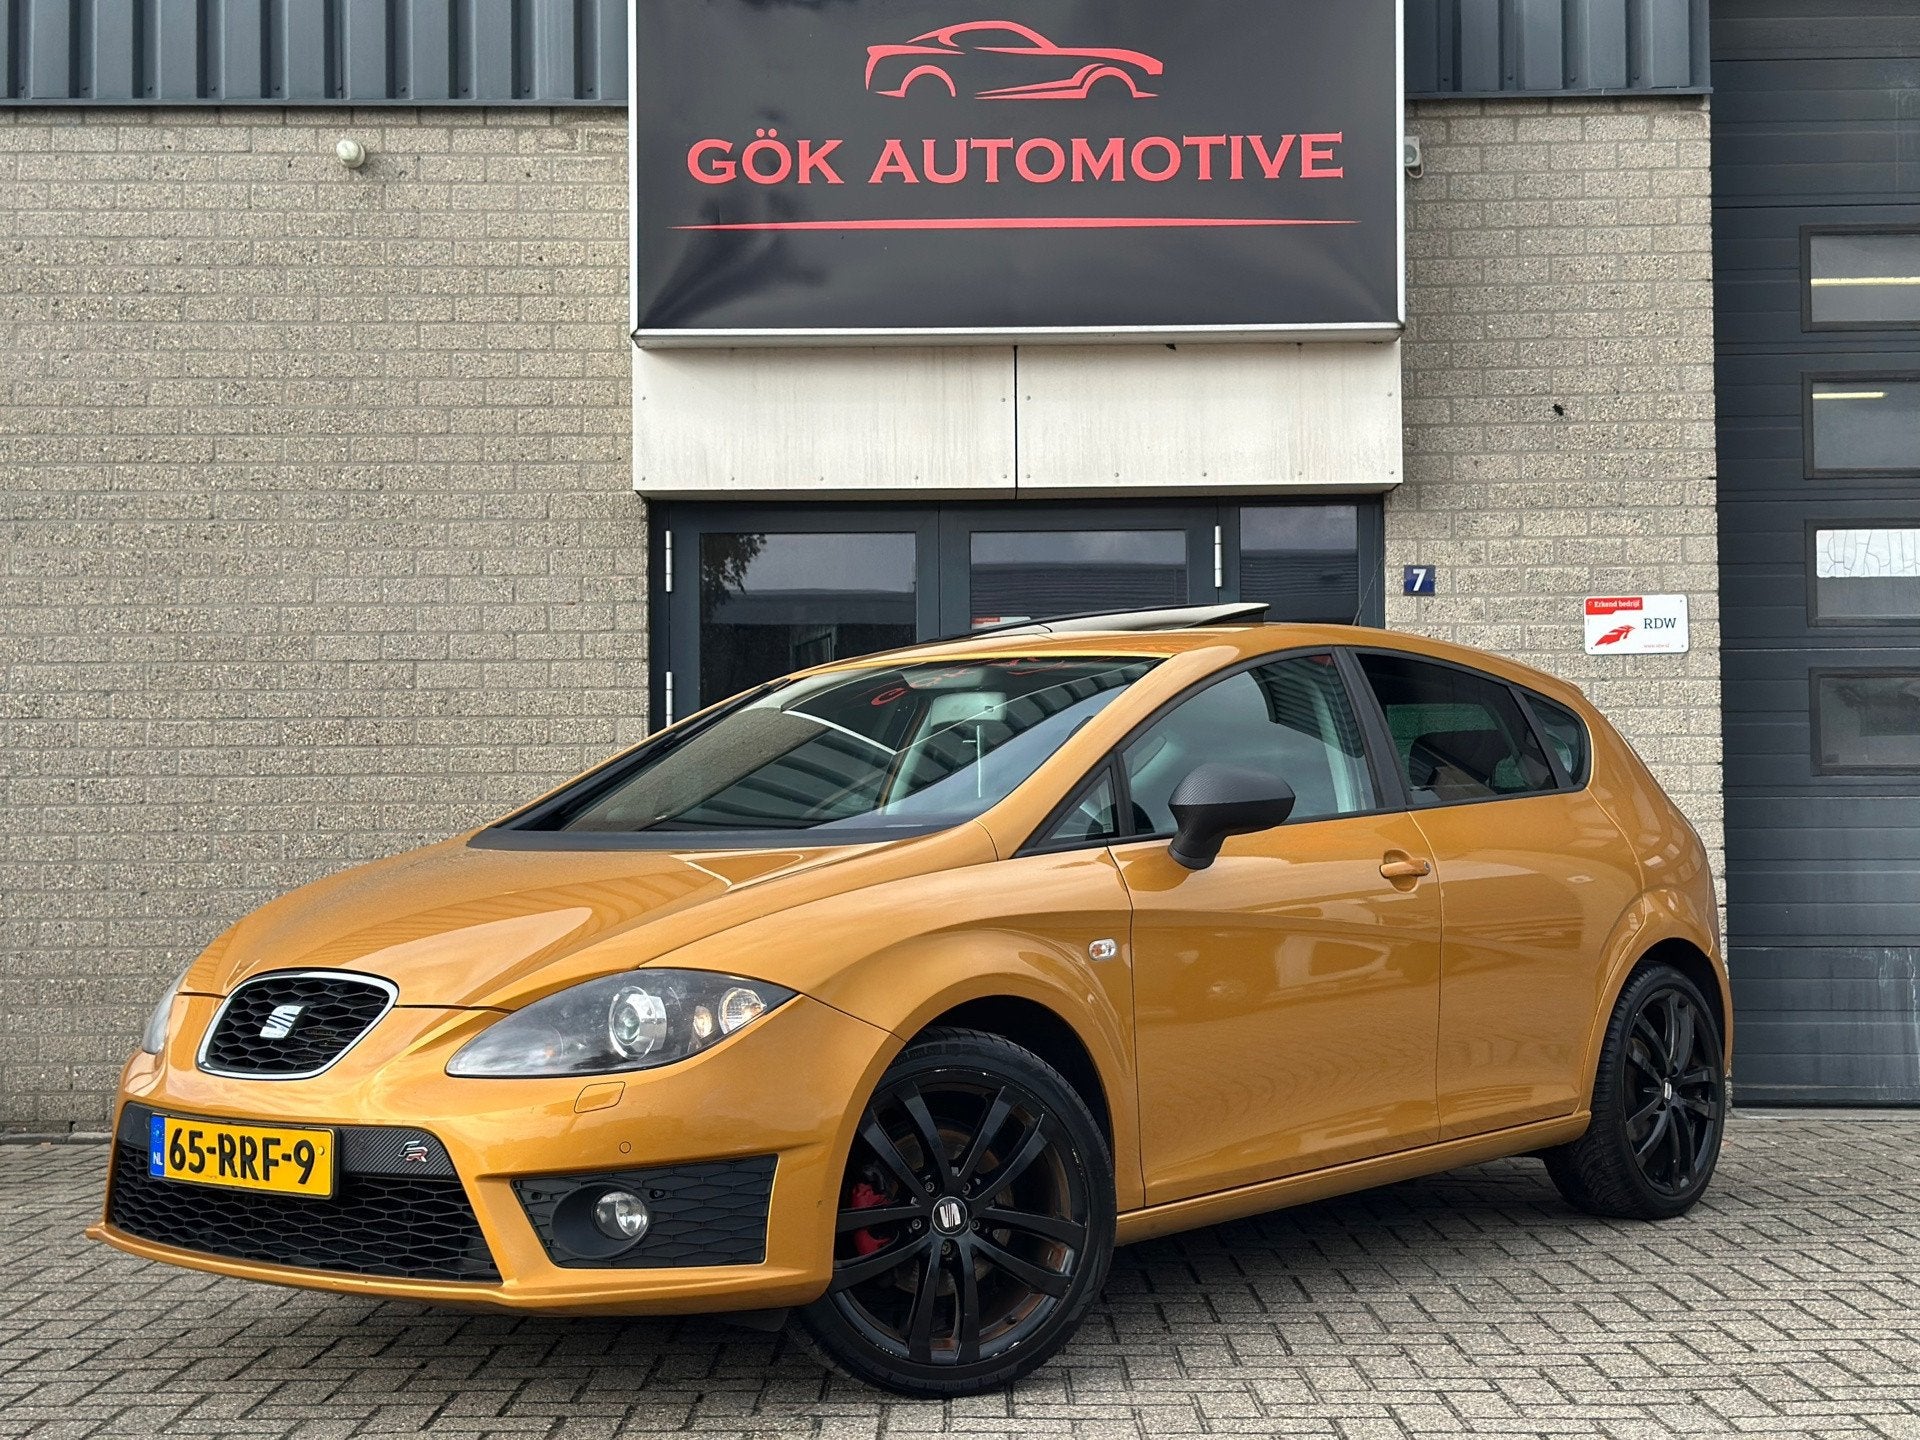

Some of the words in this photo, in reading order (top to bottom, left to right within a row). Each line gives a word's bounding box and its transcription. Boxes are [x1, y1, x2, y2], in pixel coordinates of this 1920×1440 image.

[687, 128, 843, 185] GÖK
[870, 132, 1345, 185] AUTOMOTIVE
[1412, 568, 1427, 592] 7
[1594, 600, 1617, 608] Erkend
[1643, 617, 1677, 629] RDW
[152, 1151, 163, 1166] NL
[169, 1127, 316, 1185] 65-RRF-9
